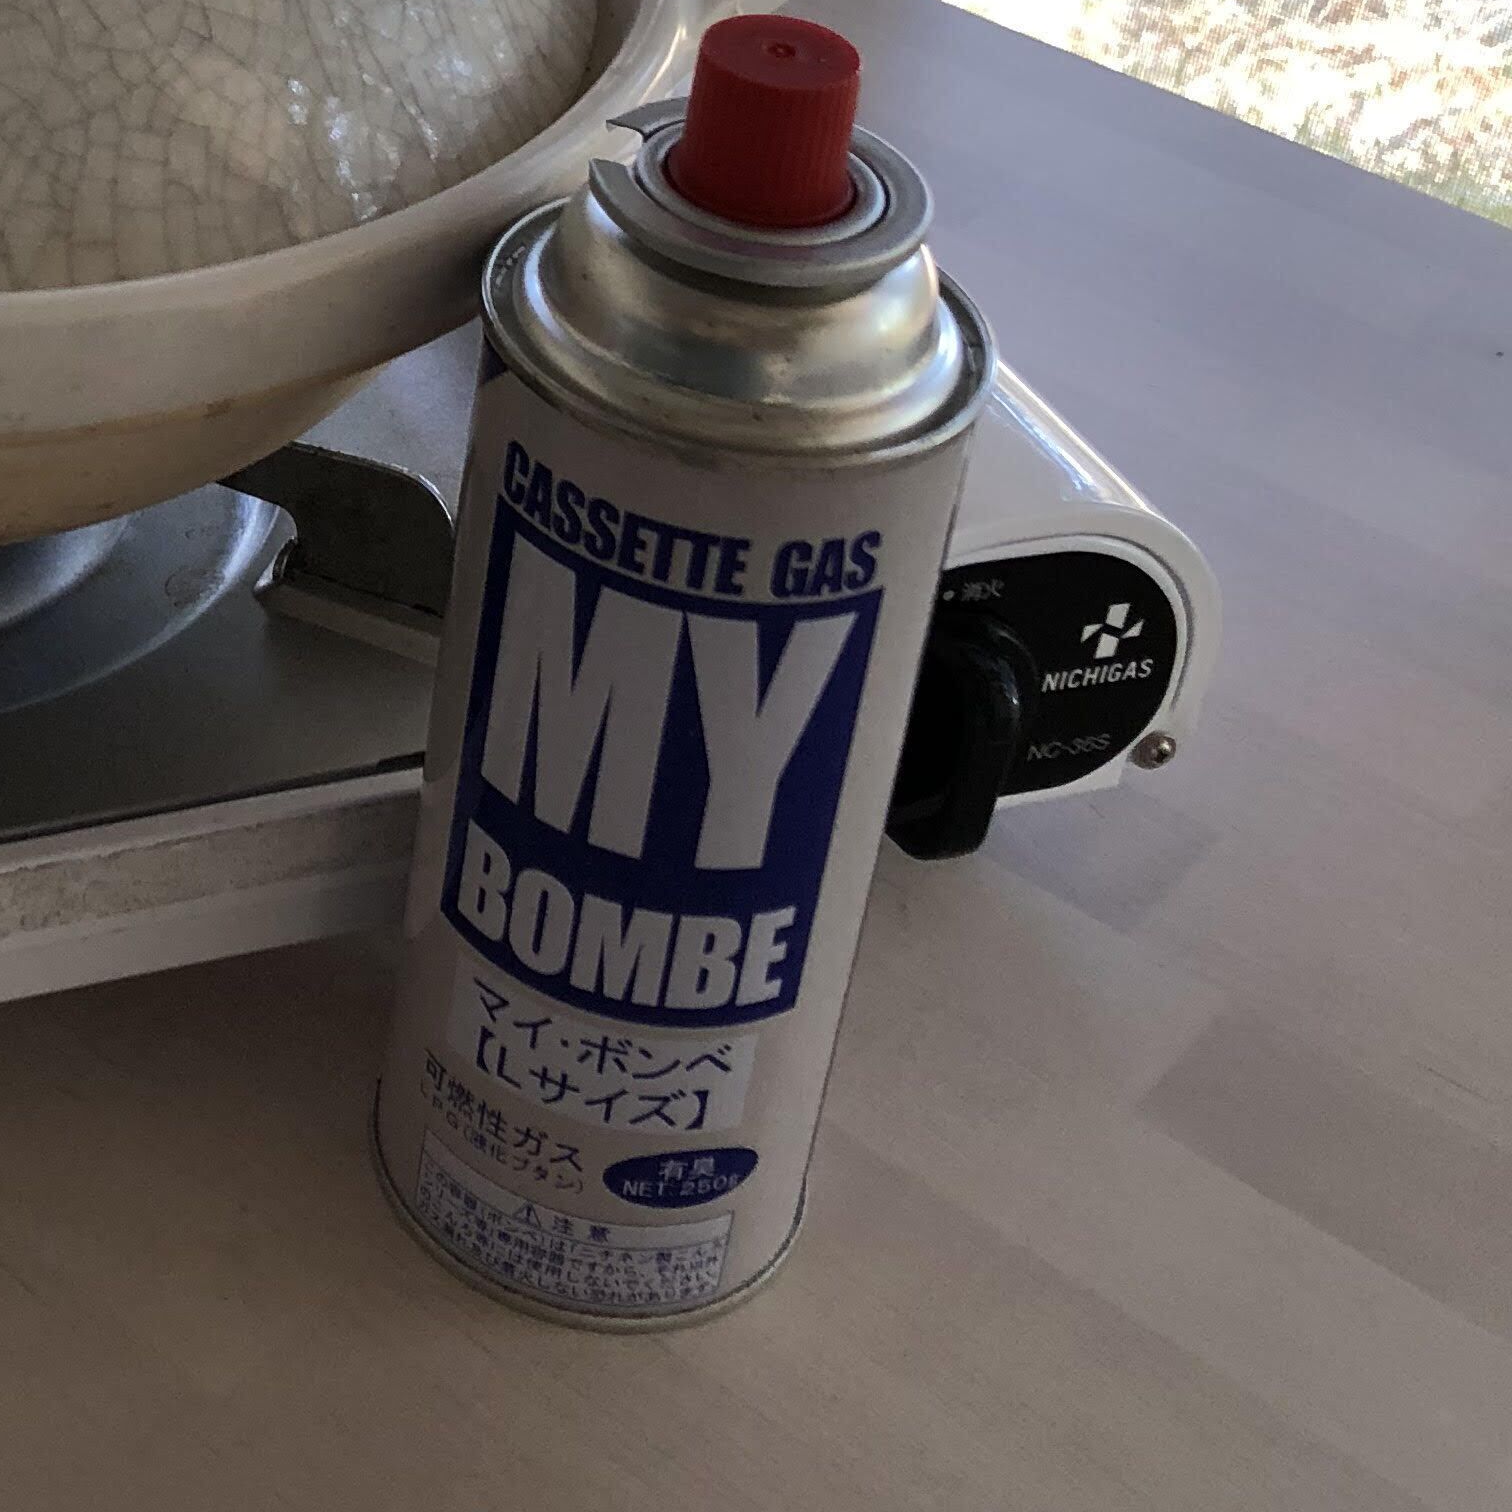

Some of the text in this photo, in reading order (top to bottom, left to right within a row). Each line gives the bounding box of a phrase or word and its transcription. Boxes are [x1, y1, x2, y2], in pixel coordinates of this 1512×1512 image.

[502, 440, 884, 598] CASSETTE GAS
[480, 528, 859, 870] MY
[1041, 658, 1154, 693] NICHIGAS
[456, 815, 797, 1009] BOMBE
[473, 977, 733, 1080] マイ・ボンベ
[424, 1047, 584, 1173] 可燃性ガス
